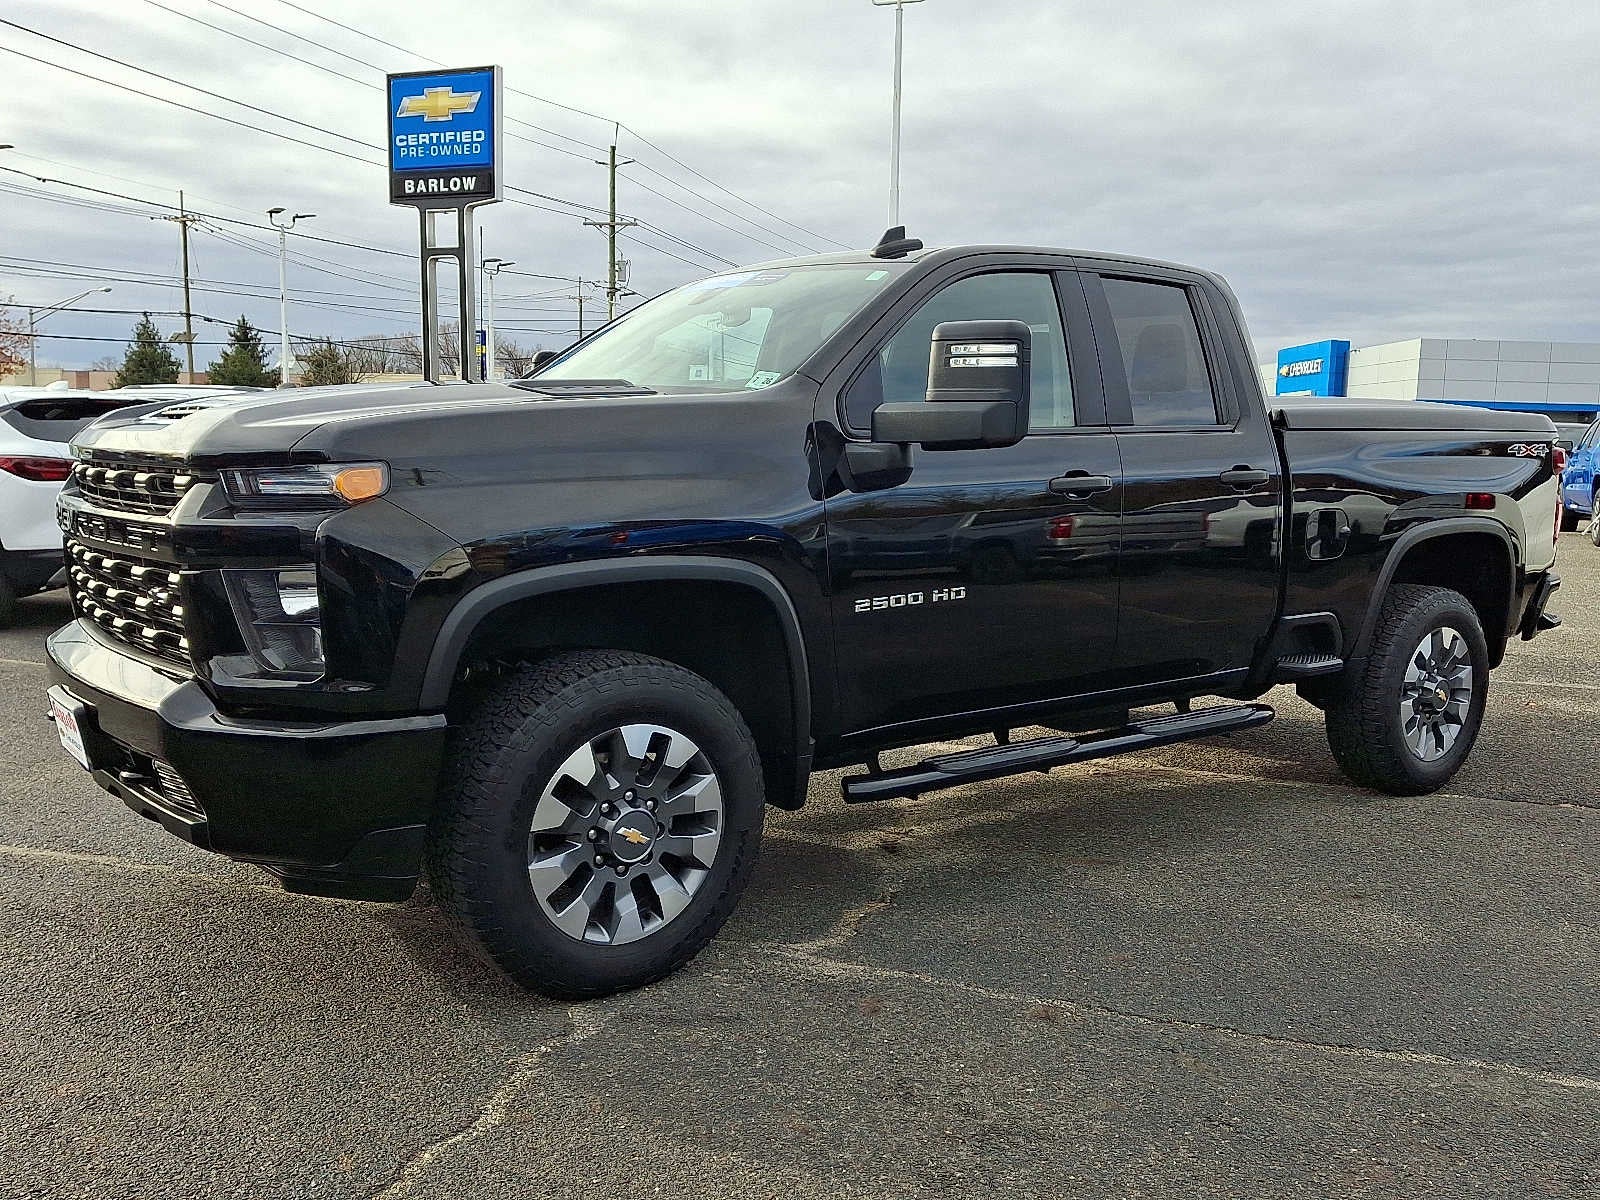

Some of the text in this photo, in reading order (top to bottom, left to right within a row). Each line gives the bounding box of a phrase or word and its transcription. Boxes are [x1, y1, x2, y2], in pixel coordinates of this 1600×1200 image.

[395, 130, 485, 147] CERTIFIED
[400, 143, 481, 158] PRE-OWNED
[404, 176, 477, 194] BARLOW
[1290, 359, 1324, 377] CHEVROLET
[855, 586, 966, 613] 2500 HD
